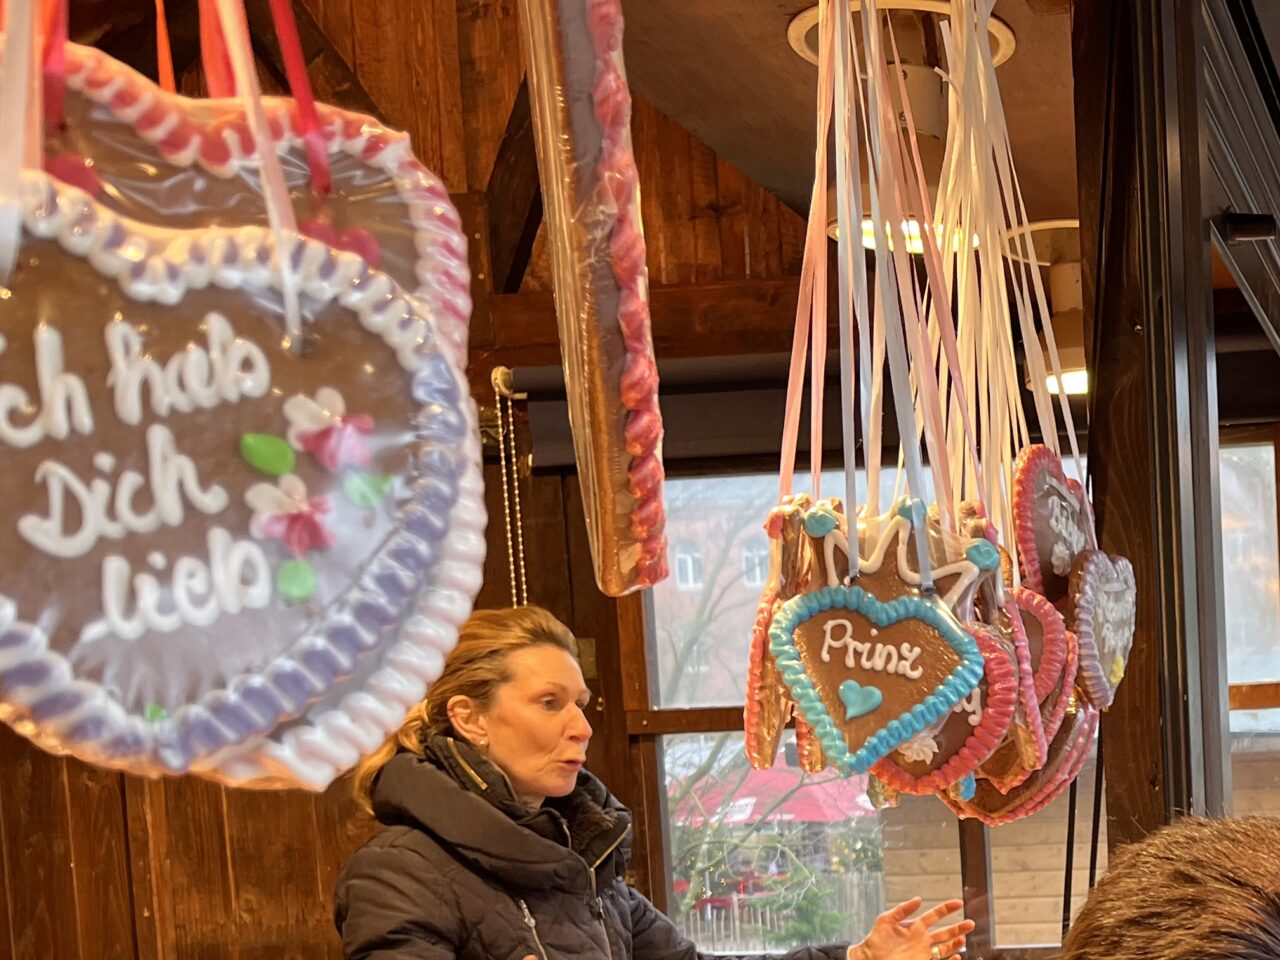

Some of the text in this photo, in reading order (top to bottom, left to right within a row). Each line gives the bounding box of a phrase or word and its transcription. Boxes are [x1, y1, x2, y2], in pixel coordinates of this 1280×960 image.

[0, 311, 271, 448] ch hab
[17, 424, 229, 558] Dich
[100, 526, 272, 640] lieb
[821, 618, 923, 680] Prinz
